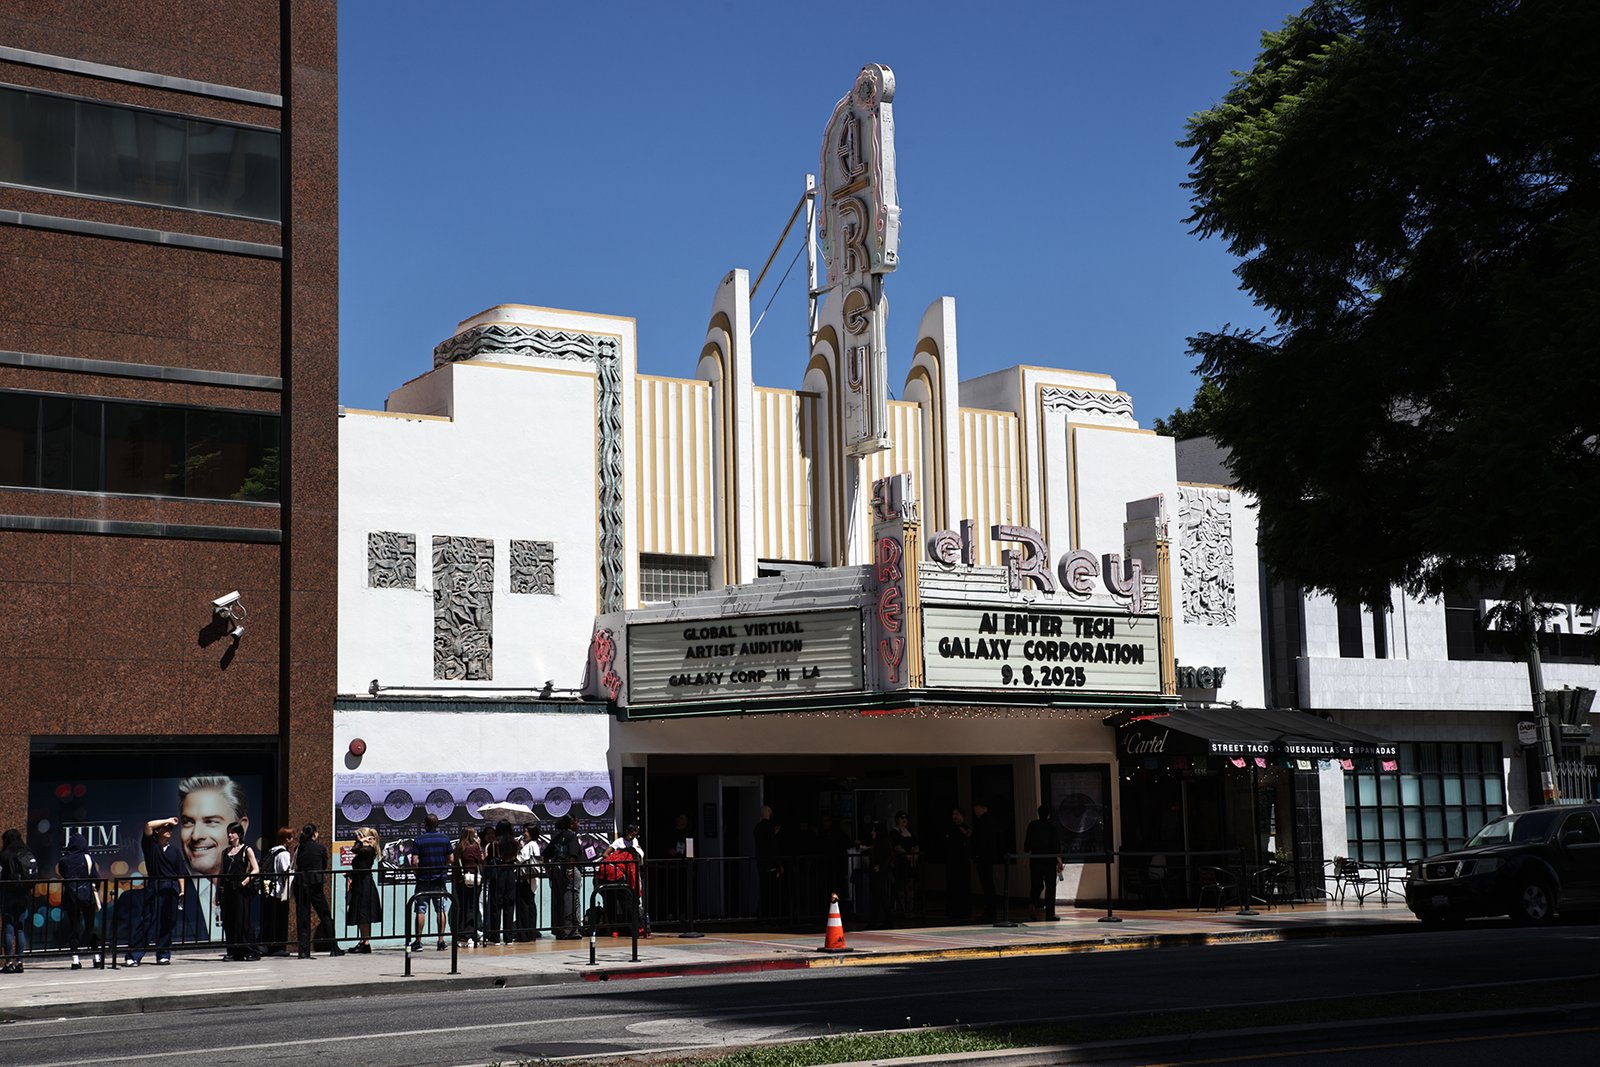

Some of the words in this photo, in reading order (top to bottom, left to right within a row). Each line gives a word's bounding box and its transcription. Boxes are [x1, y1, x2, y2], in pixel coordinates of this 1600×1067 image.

[683, 625, 737, 641] GLOBAL
[744, 620, 804, 637] VIRTUAL
[979, 612, 998, 635] AI
[1004, 614, 1063, 638] ENTER
[1073, 617, 1115, 640] TECH
[685, 644, 735, 660] ARTIST
[740, 639, 803, 656] AUDITION
[938, 636, 1012, 660] GALAXY
[1023, 640, 1144, 665] CORPORATION
[669, 671, 724, 687] GALAXY
[730, 669, 768, 684] CORP
[777, 667, 791, 682] IN
[803, 665, 821, 680] LA
[1127, 729, 1169, 754] Cartel
[1211, 743, 1244, 752] STREET
[1247, 744, 1274, 753] TACOS
[1284, 745, 1340, 754] QUESADILLAS
[1349, 746, 1396, 755] EMPANADAS
